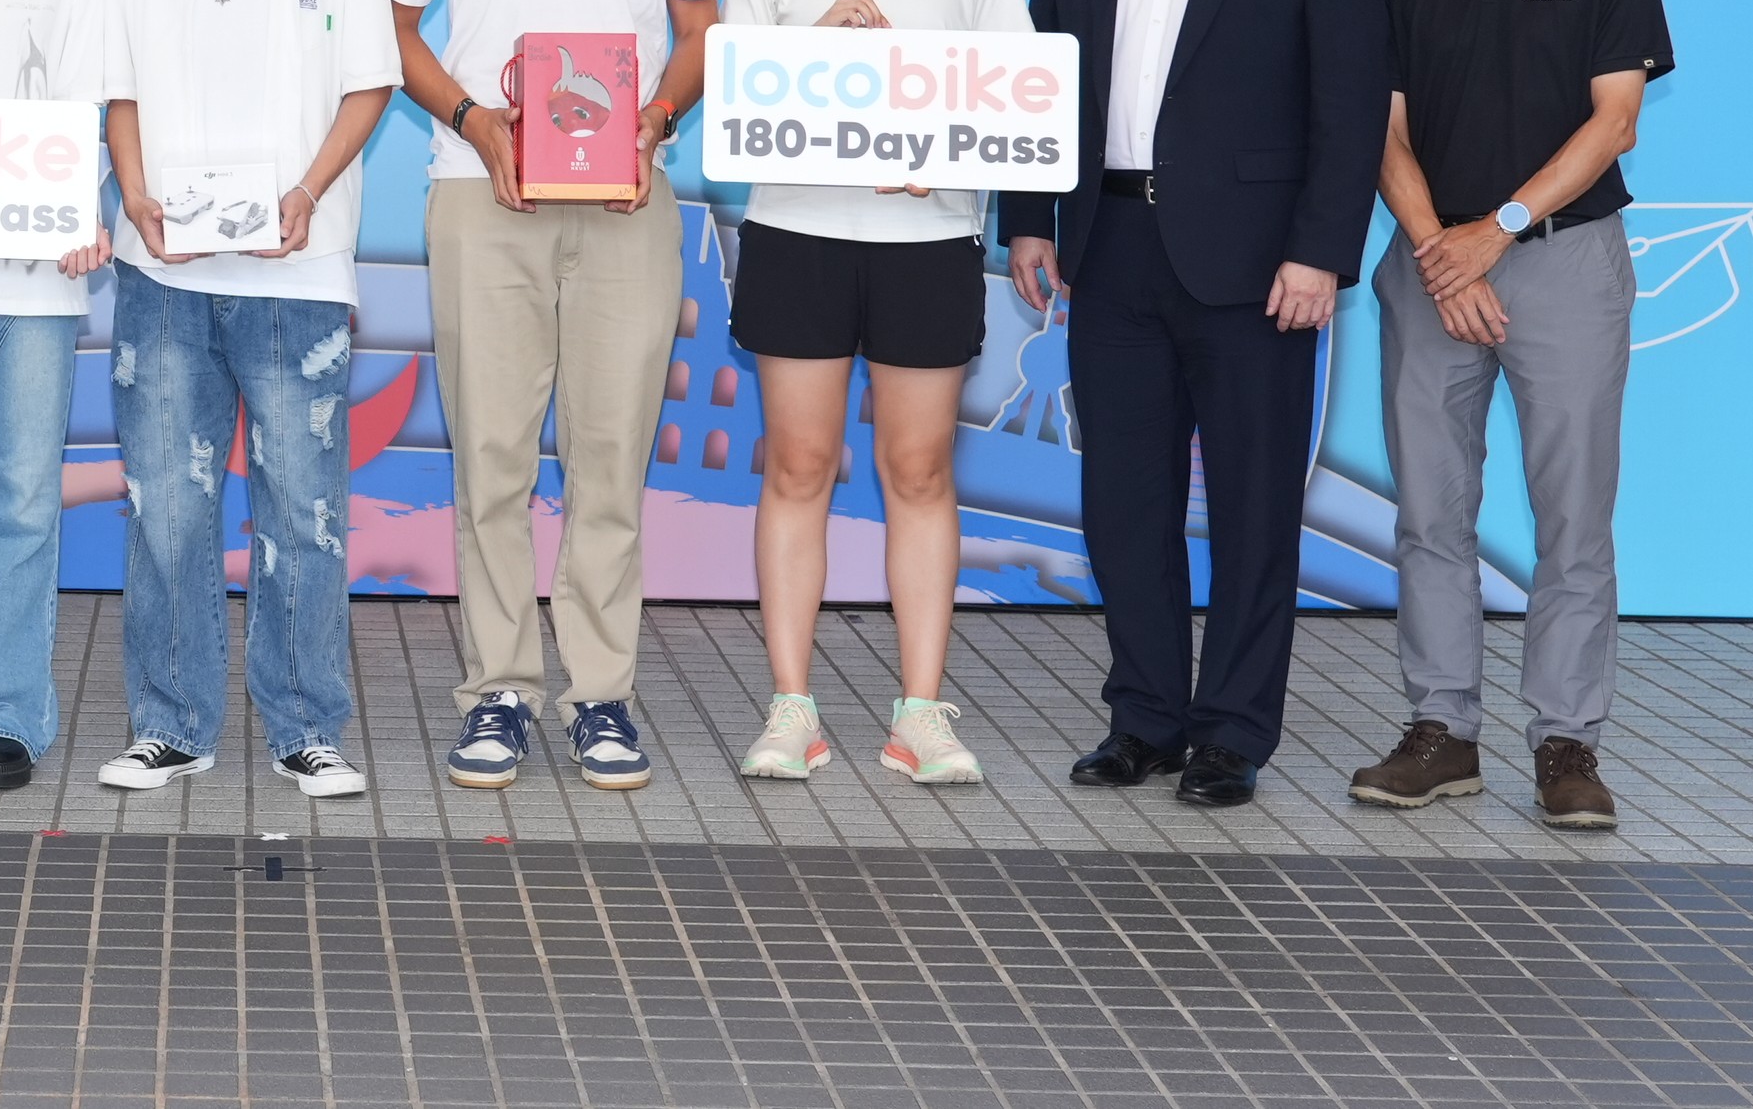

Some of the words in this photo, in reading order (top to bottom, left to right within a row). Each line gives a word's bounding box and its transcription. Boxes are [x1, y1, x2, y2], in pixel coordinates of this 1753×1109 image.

[722, 41, 1060, 114] locobike
[721, 118, 935, 172] 180-Day
[948, 123, 1061, 166] Pass
